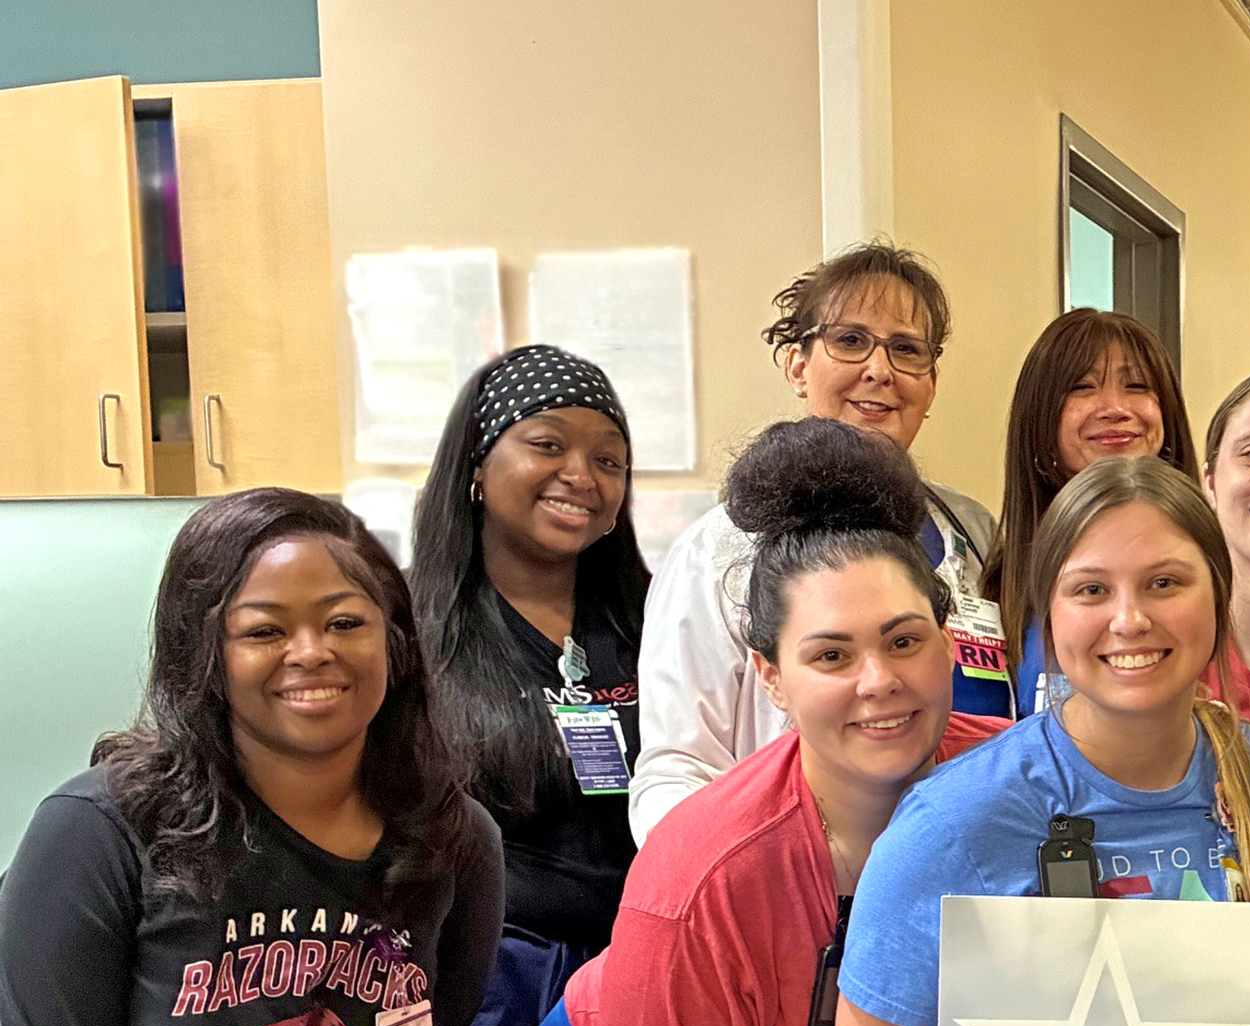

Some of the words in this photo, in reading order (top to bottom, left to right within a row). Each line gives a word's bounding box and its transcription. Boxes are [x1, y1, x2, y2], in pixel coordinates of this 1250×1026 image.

[953, 631, 973, 641] MAY
[959, 645, 1000, 670] RN
[1150, 847, 1191, 872] TO
